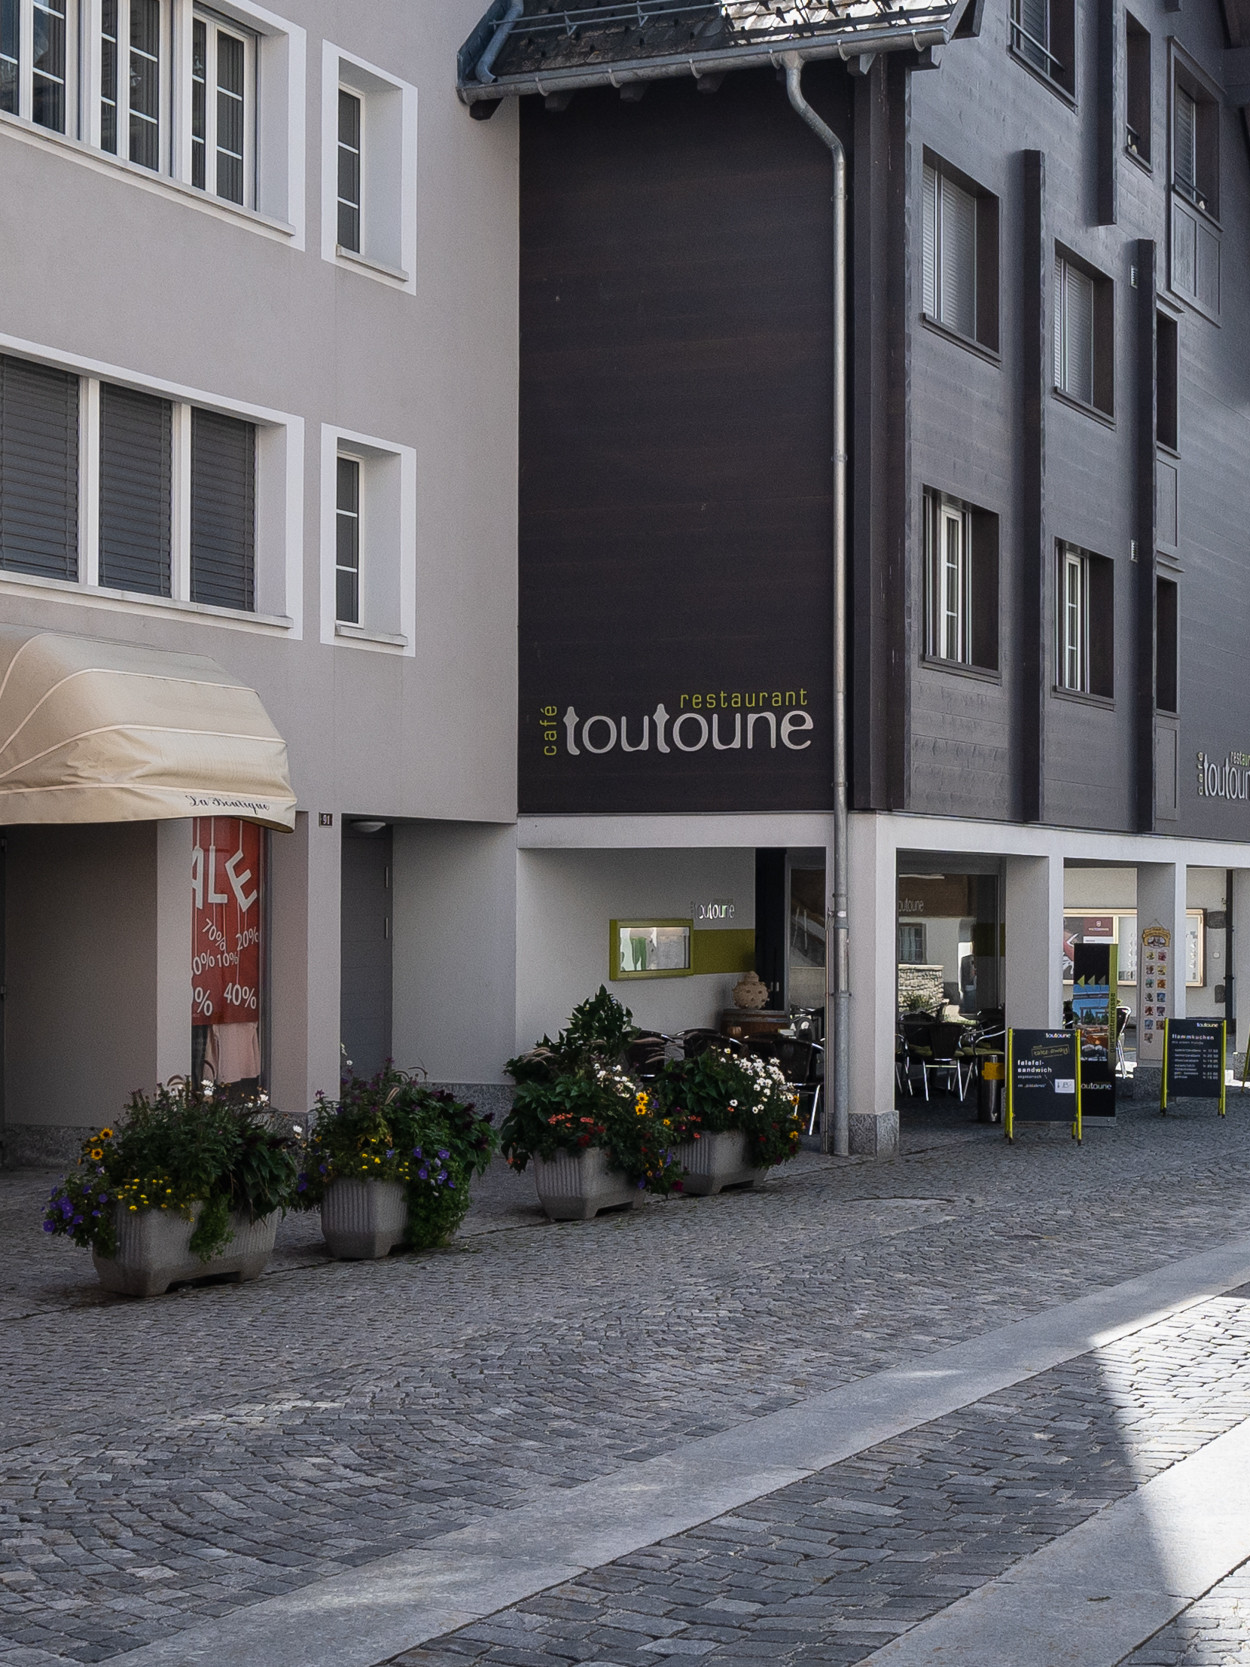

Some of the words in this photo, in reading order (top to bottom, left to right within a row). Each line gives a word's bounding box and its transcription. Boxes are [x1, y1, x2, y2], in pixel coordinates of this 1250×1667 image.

[680, 688, 807, 708] restaurant
[540, 705, 557, 756] café
[562, 703, 814, 756] toutoune
[185, 795, 208, 807] La
[211, 797, 270, 815] Boutique
[322, 814, 331, 823] 91
[192, 845, 258, 913] ALE
[202, 917, 226, 951] 70%
[236, 926, 259, 951] 20%
[193, 949, 215, 975] 0%
[217, 952, 239, 967] 10%
[224, 982, 257, 1010] 40%
[1080, 1082, 1113, 1091] outoune
